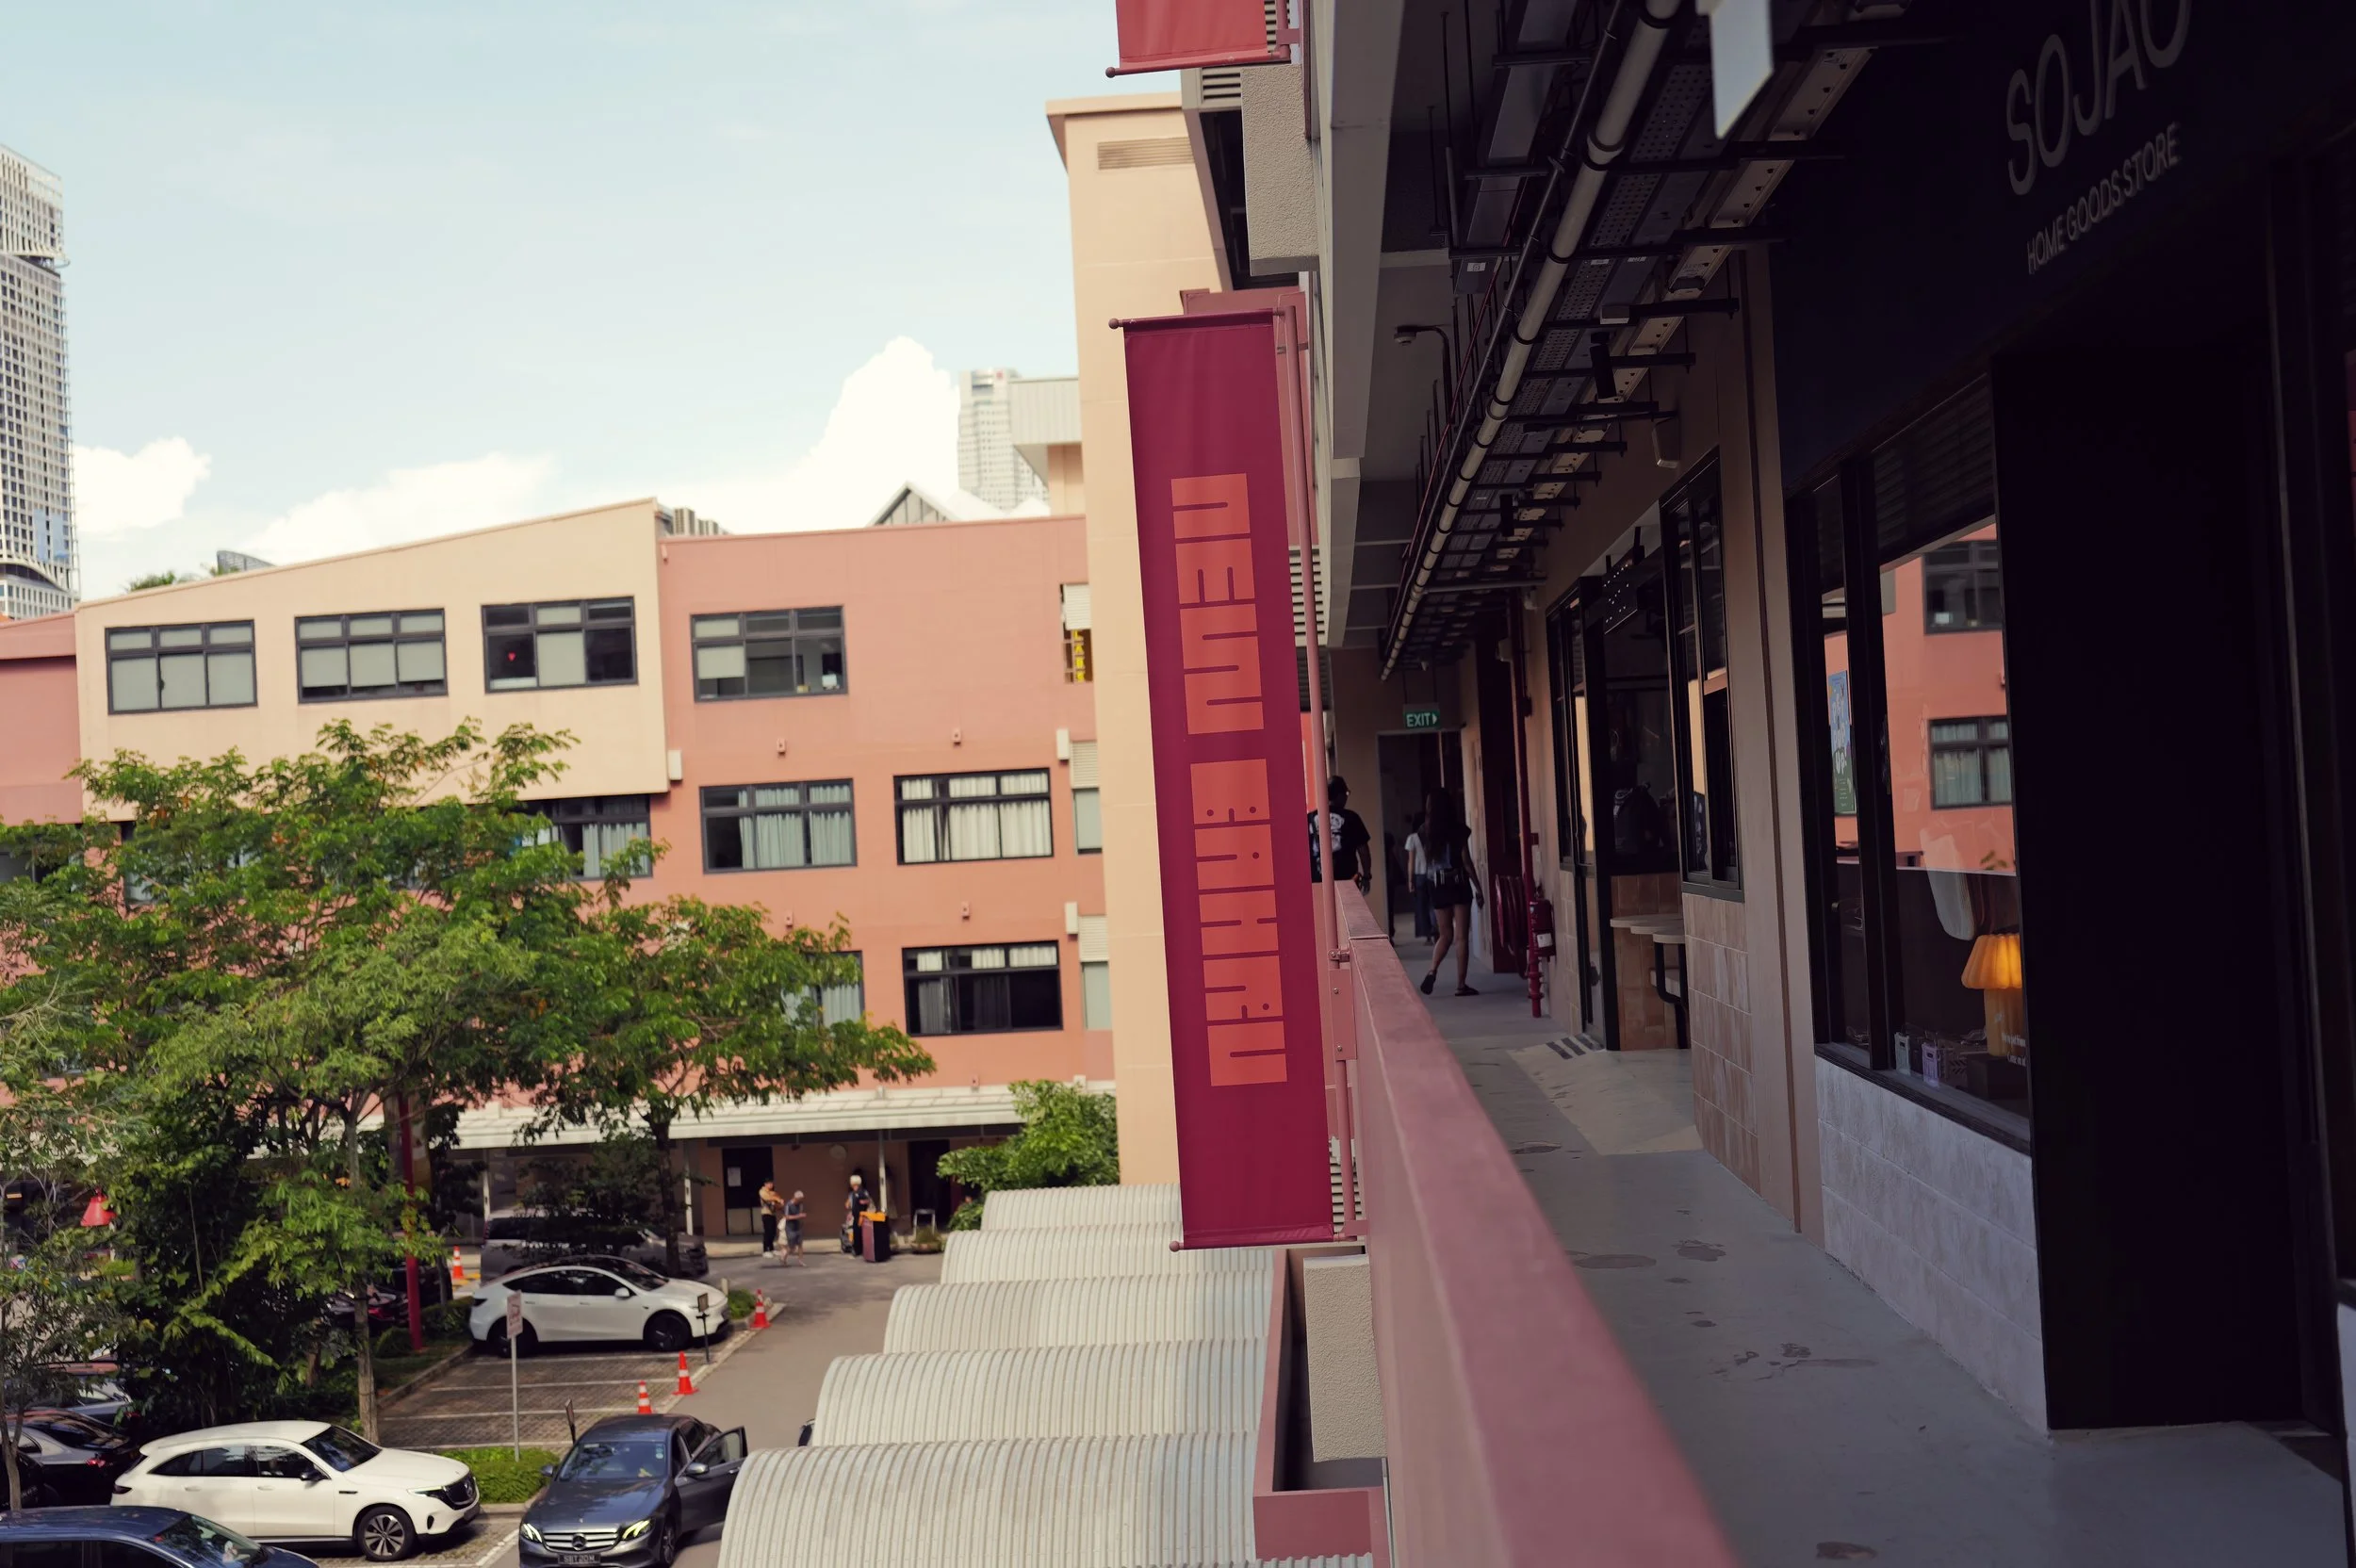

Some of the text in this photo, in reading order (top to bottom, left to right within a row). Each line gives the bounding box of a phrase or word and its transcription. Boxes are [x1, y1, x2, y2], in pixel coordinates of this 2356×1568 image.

[2027, 121, 2182, 275] HOME GOODS STORE
[1406, 712, 1431, 727] EXIT
